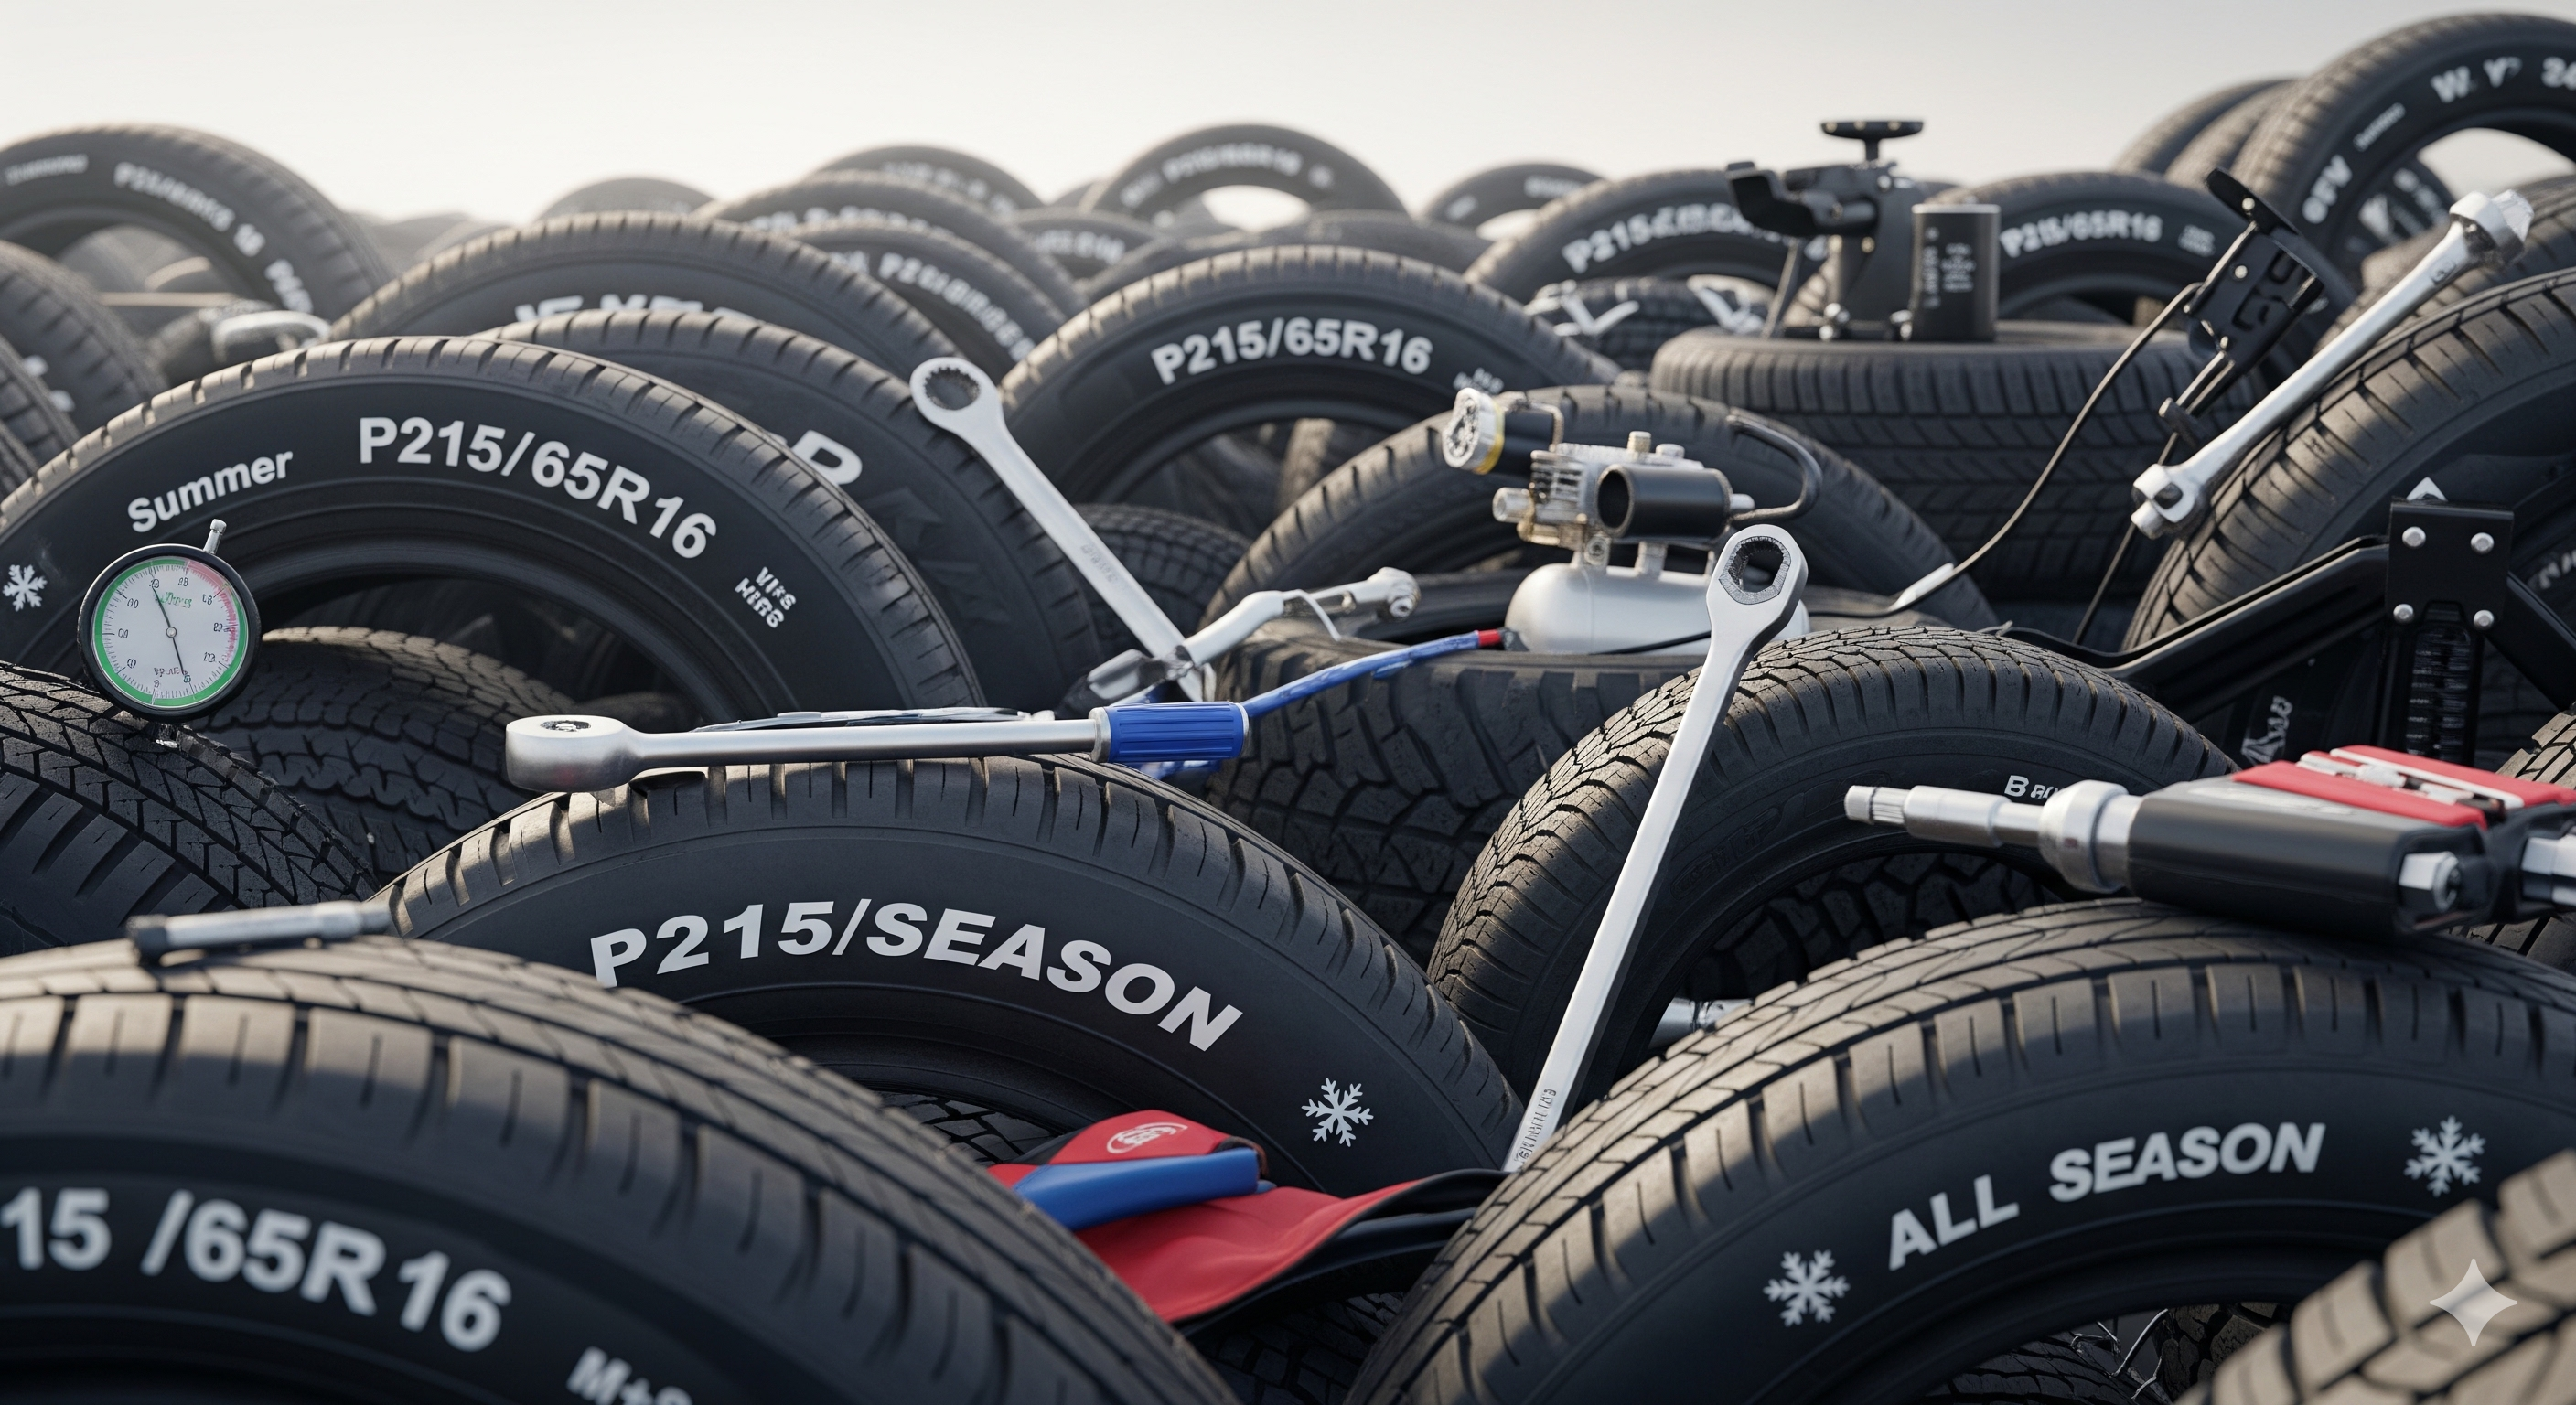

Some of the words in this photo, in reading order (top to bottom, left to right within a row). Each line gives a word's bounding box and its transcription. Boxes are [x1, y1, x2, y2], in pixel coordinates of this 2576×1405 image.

[1150, 316, 1433, 385] P215/65R16
[128, 451, 293, 532] Summer
[360, 417, 716, 559] P215/65R16
[590, 898, 1243, 1052] P215/SEASON
[1889, 1174, 2019, 1271] ALL
[2049, 1122, 2325, 1202] SEASON
